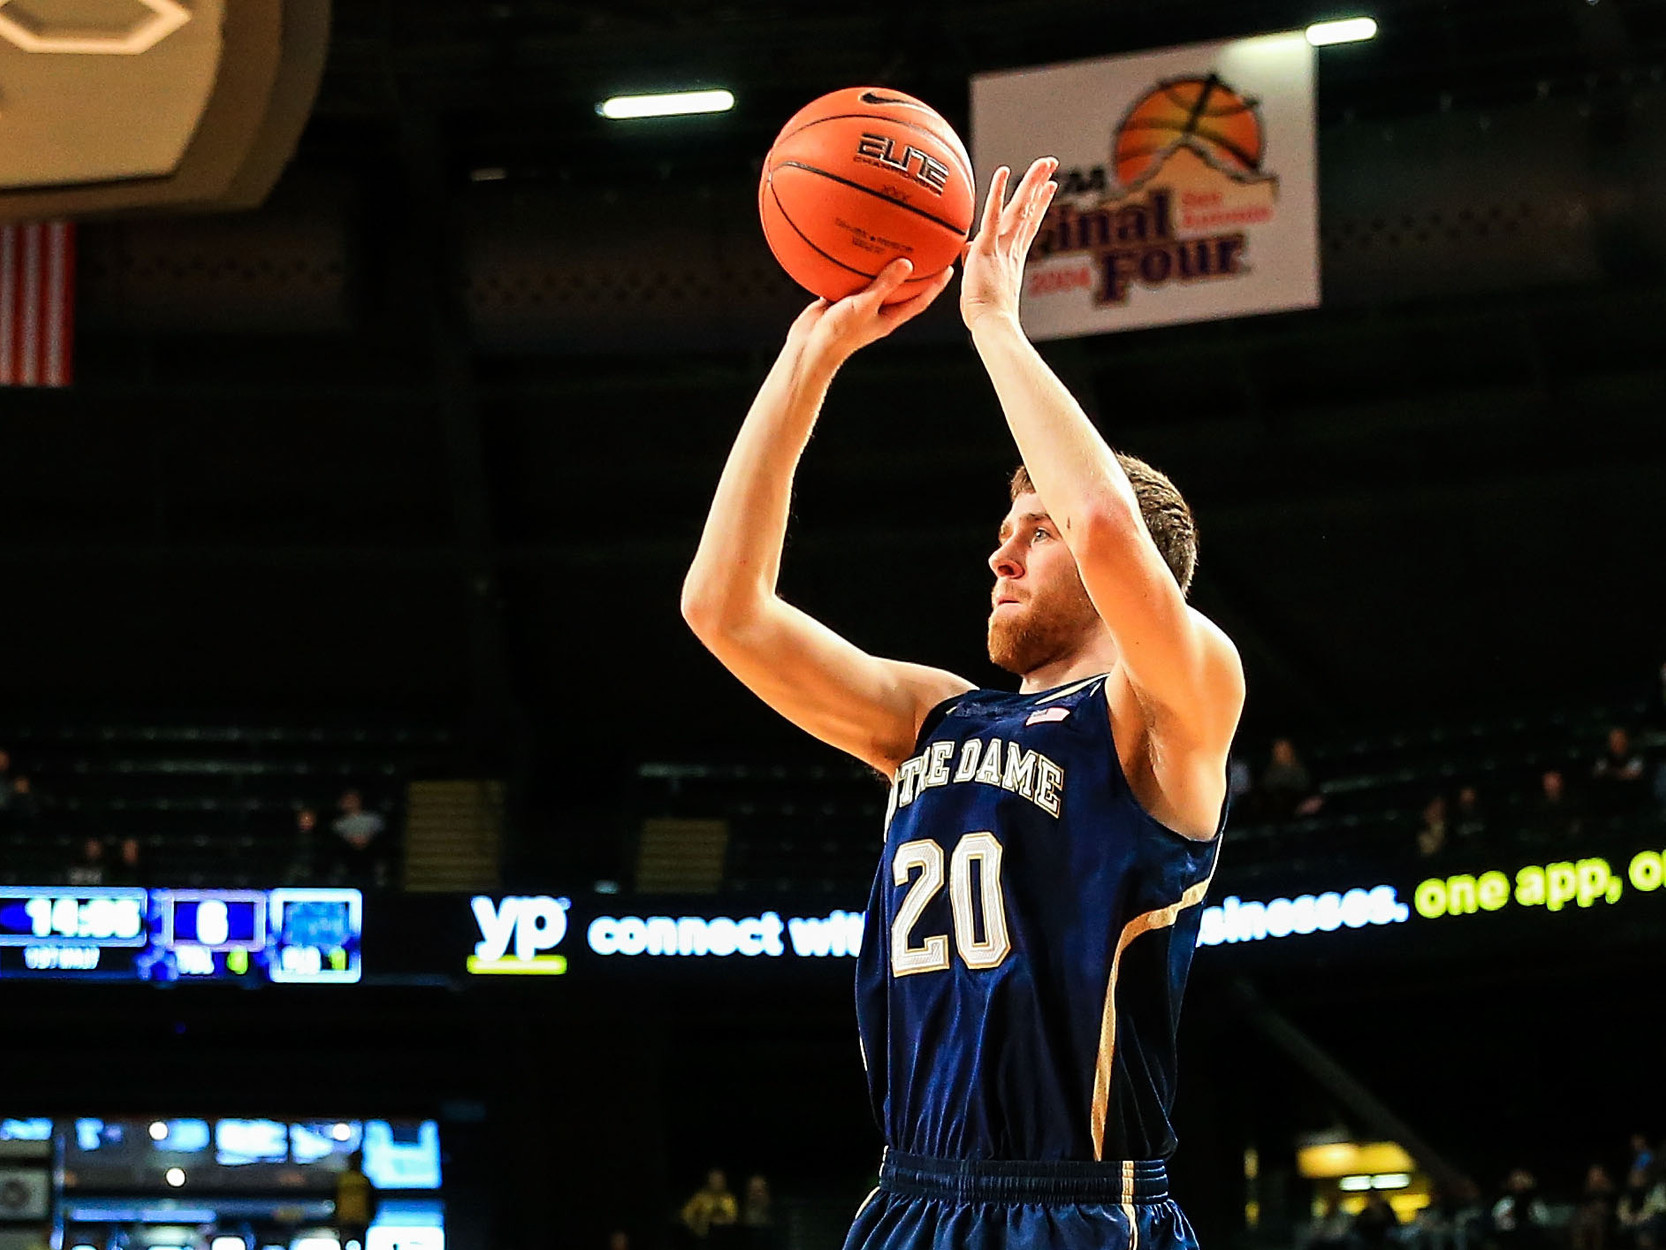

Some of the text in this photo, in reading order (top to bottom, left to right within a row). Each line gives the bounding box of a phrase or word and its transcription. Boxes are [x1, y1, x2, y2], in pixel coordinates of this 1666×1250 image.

[858, 132, 949, 193] ELITE
[1094, 231, 1250, 304] Four
[953, 738, 1064, 818] DAME
[891, 831, 1011, 977] 20
[1415, 850, 1666, 918] one app, o
[470, 895, 568, 961] yp
[588, 912, 784, 956] connect
